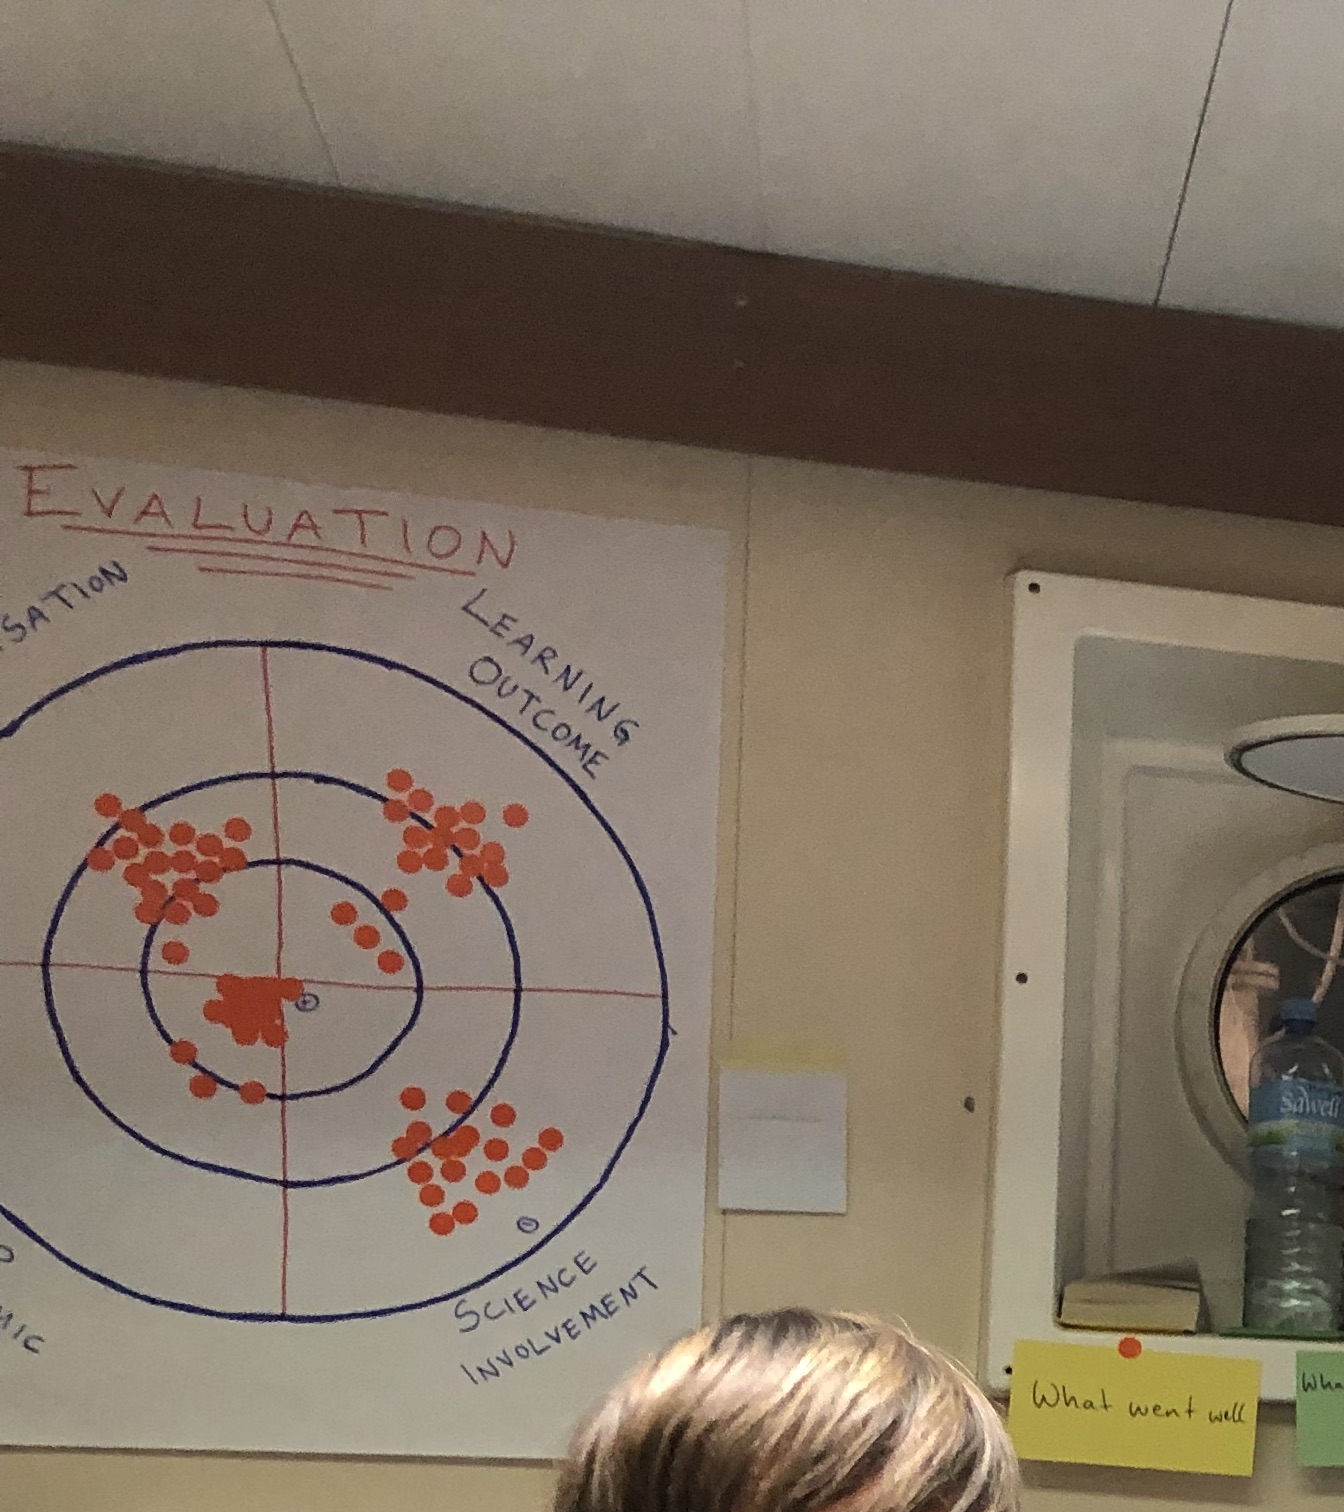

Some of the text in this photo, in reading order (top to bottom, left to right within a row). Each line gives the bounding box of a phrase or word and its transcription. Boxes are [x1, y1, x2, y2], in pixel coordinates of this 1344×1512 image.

[15, 463, 518, 568] EVALUATION
[461, 587, 641, 747] LEARNING
[468, 655, 610, 780] OUTCOME
[453, 1249, 598, 1334] SCIENCE
[460, 1265, 659, 1386] INVOLVEMENT
[1032, 1379, 1246, 1425] What went well
